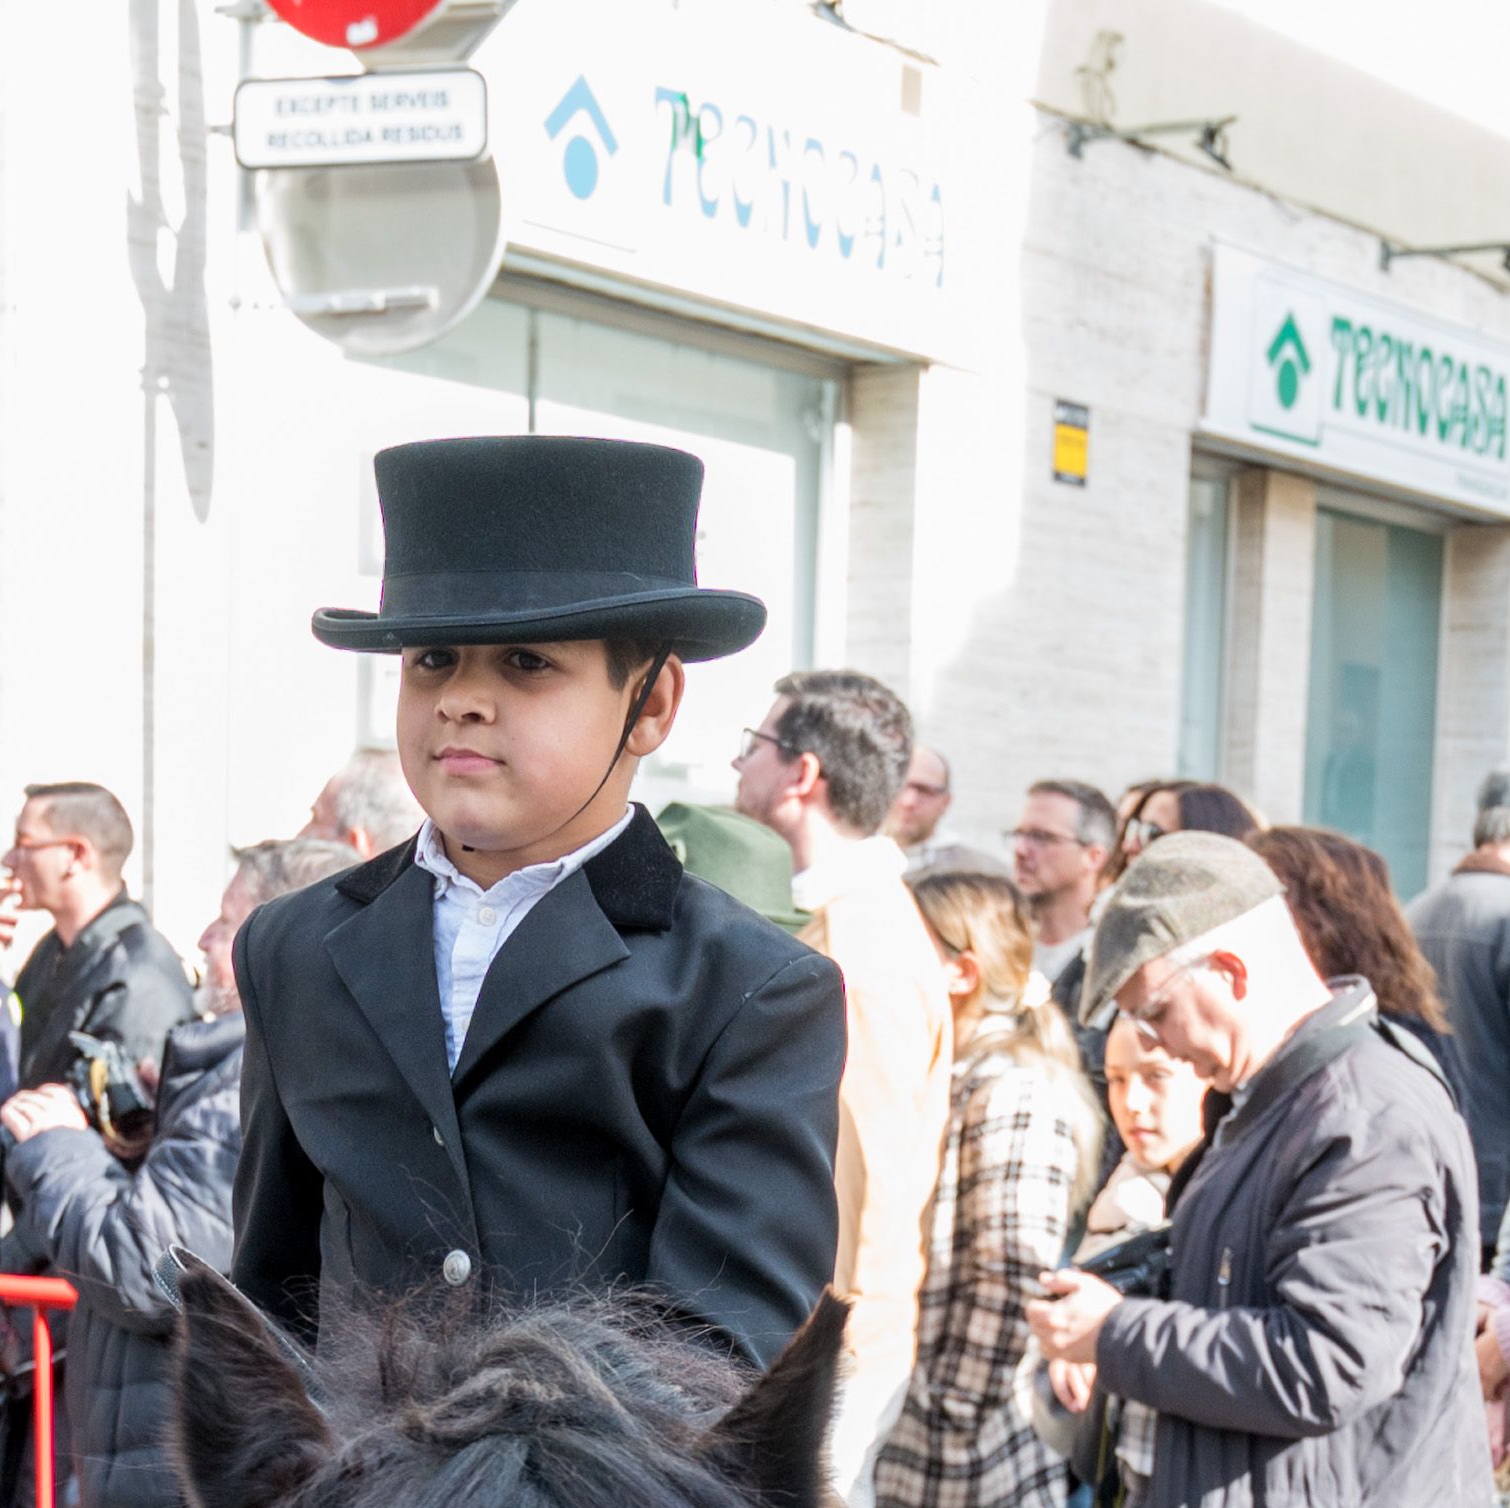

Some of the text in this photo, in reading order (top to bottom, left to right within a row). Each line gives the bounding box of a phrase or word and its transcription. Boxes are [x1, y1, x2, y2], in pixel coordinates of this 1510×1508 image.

[275, 89, 449, 117] EXCEPTE SERVEIS
[267, 123, 464, 149] RECOLLIDA RESIDUS
[1330, 314, 1508, 460] TECNOCASA
